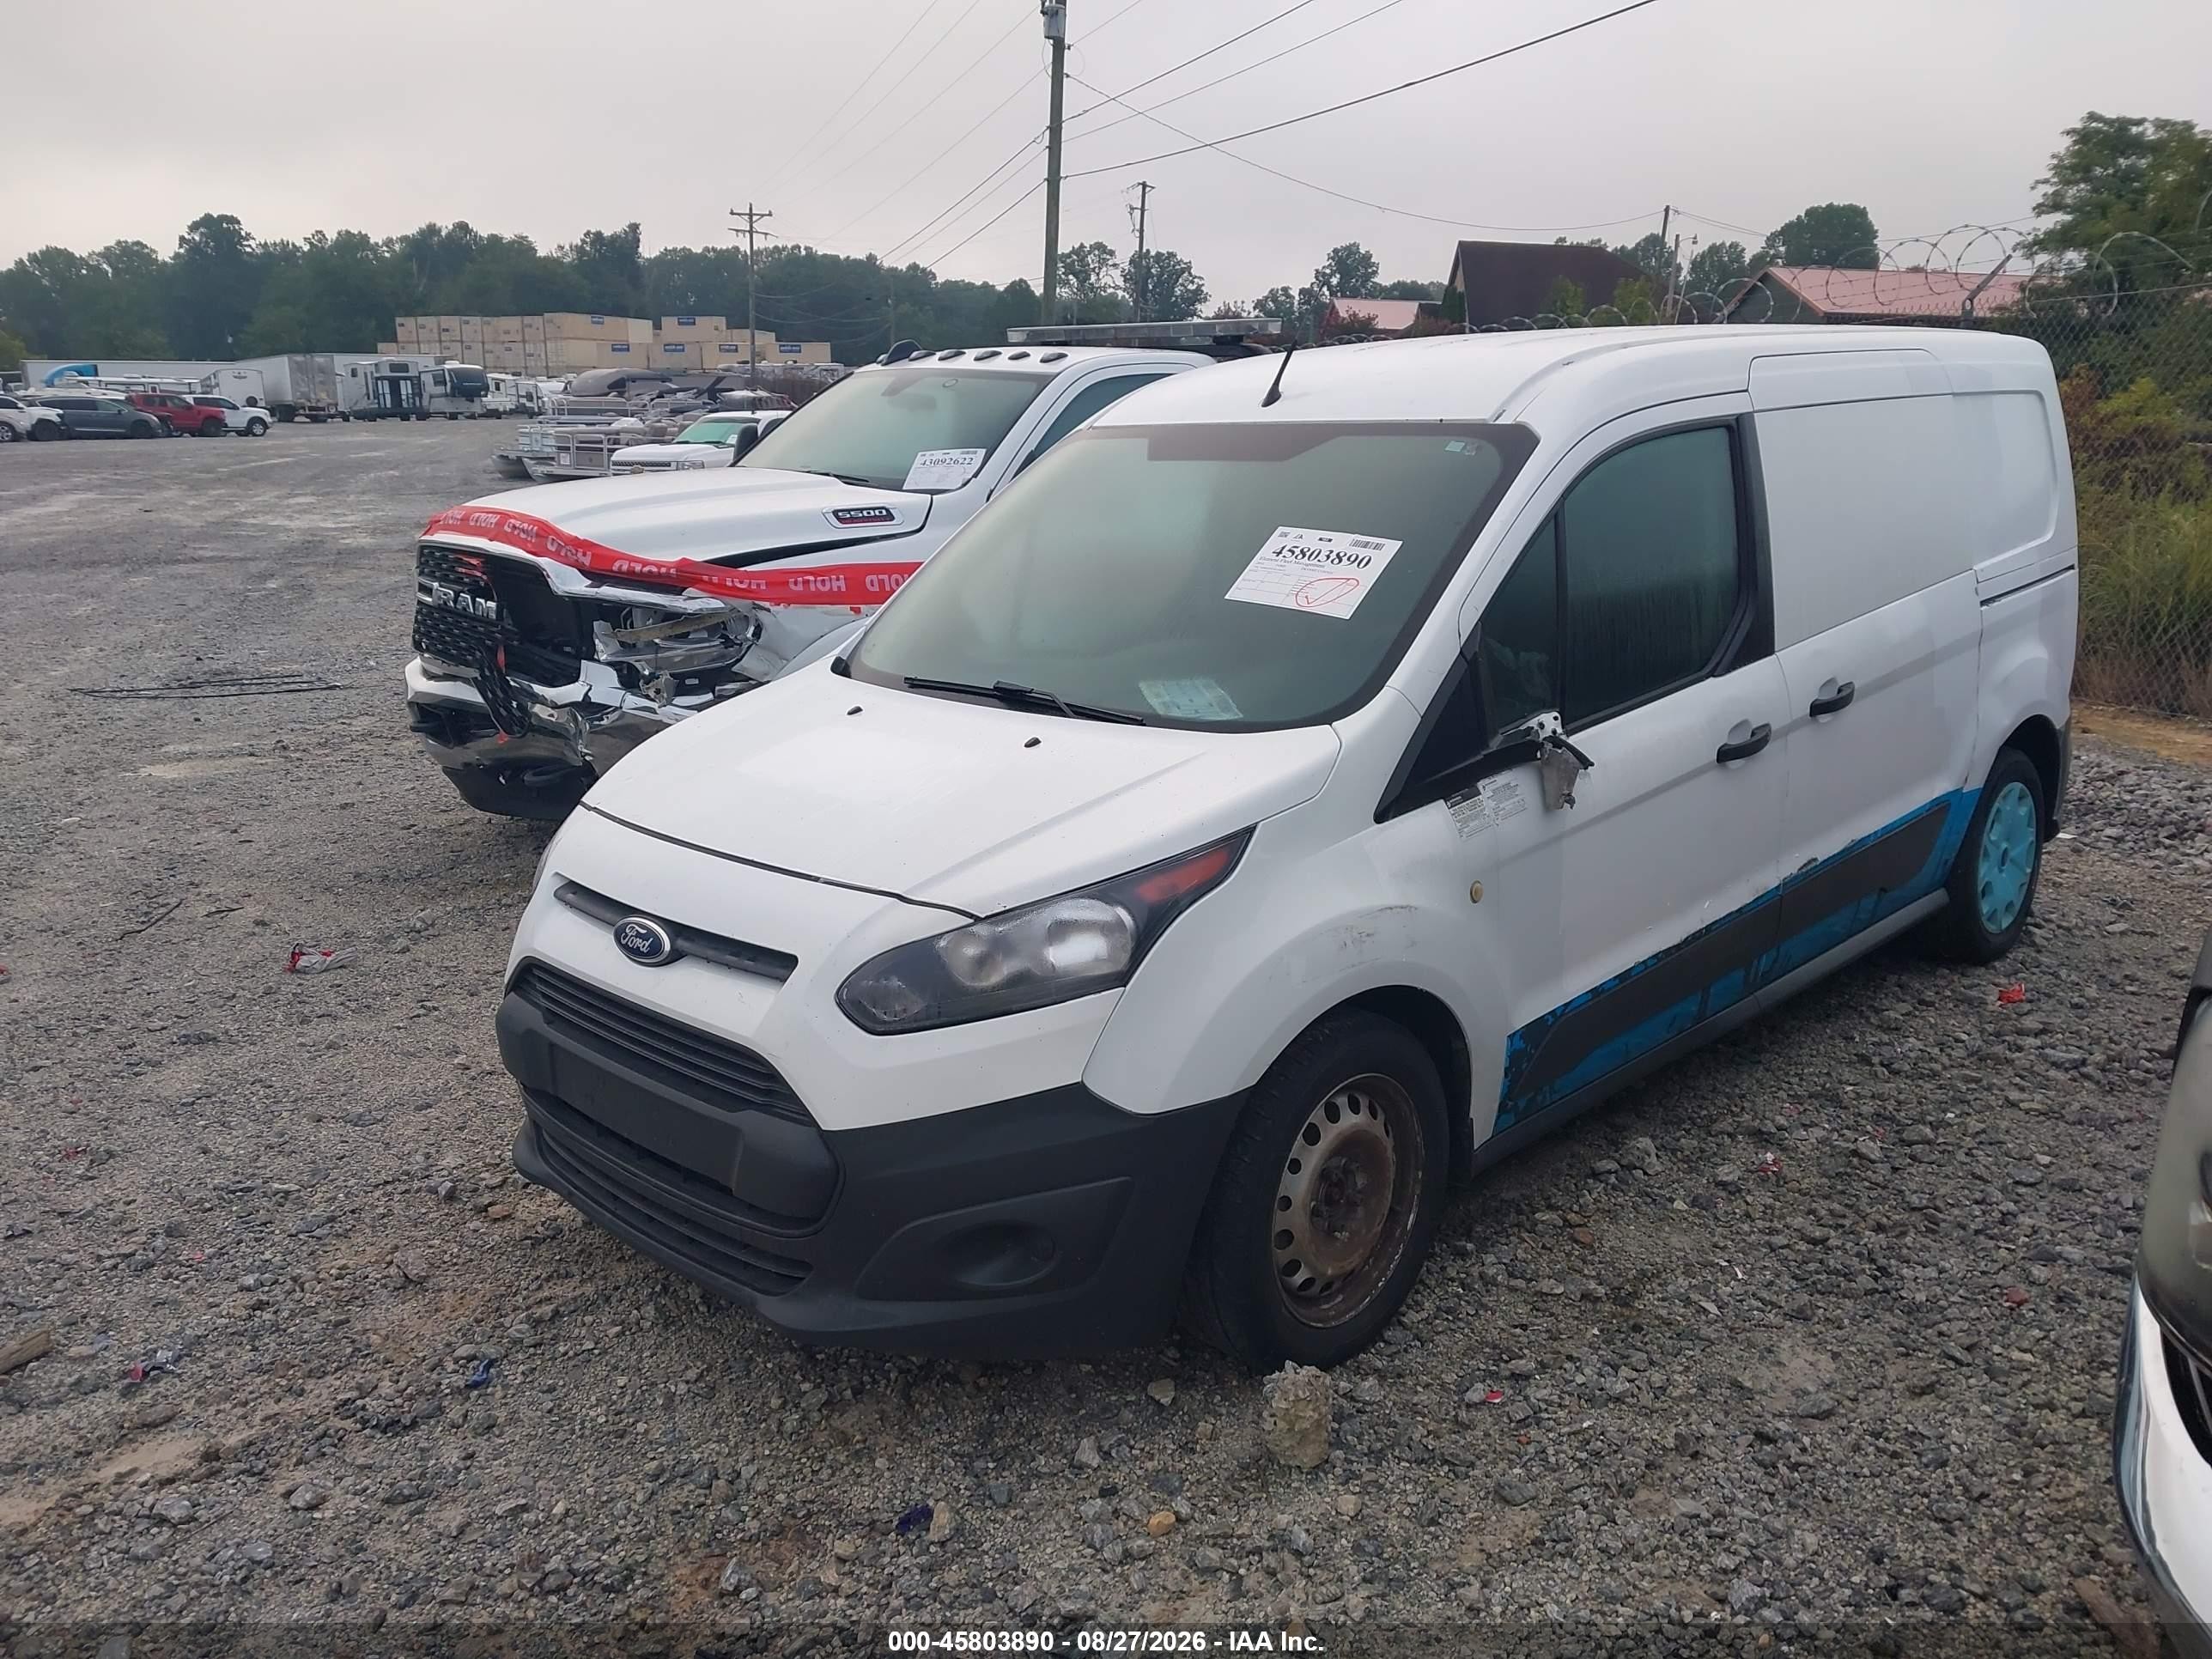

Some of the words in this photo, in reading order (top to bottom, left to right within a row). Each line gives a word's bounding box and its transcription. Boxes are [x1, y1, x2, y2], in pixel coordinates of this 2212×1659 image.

[920, 457, 975, 466] 43092622
[469, 512, 500, 529] HOLD
[837, 508, 887, 519] 5500
[503, 519, 538, 543] HOLD
[546, 535, 592, 567] HOLD
[1272, 544, 1372, 569] 45803890
[432, 586, 497, 619] RAM
[621, 923, 653, 953] Ford
